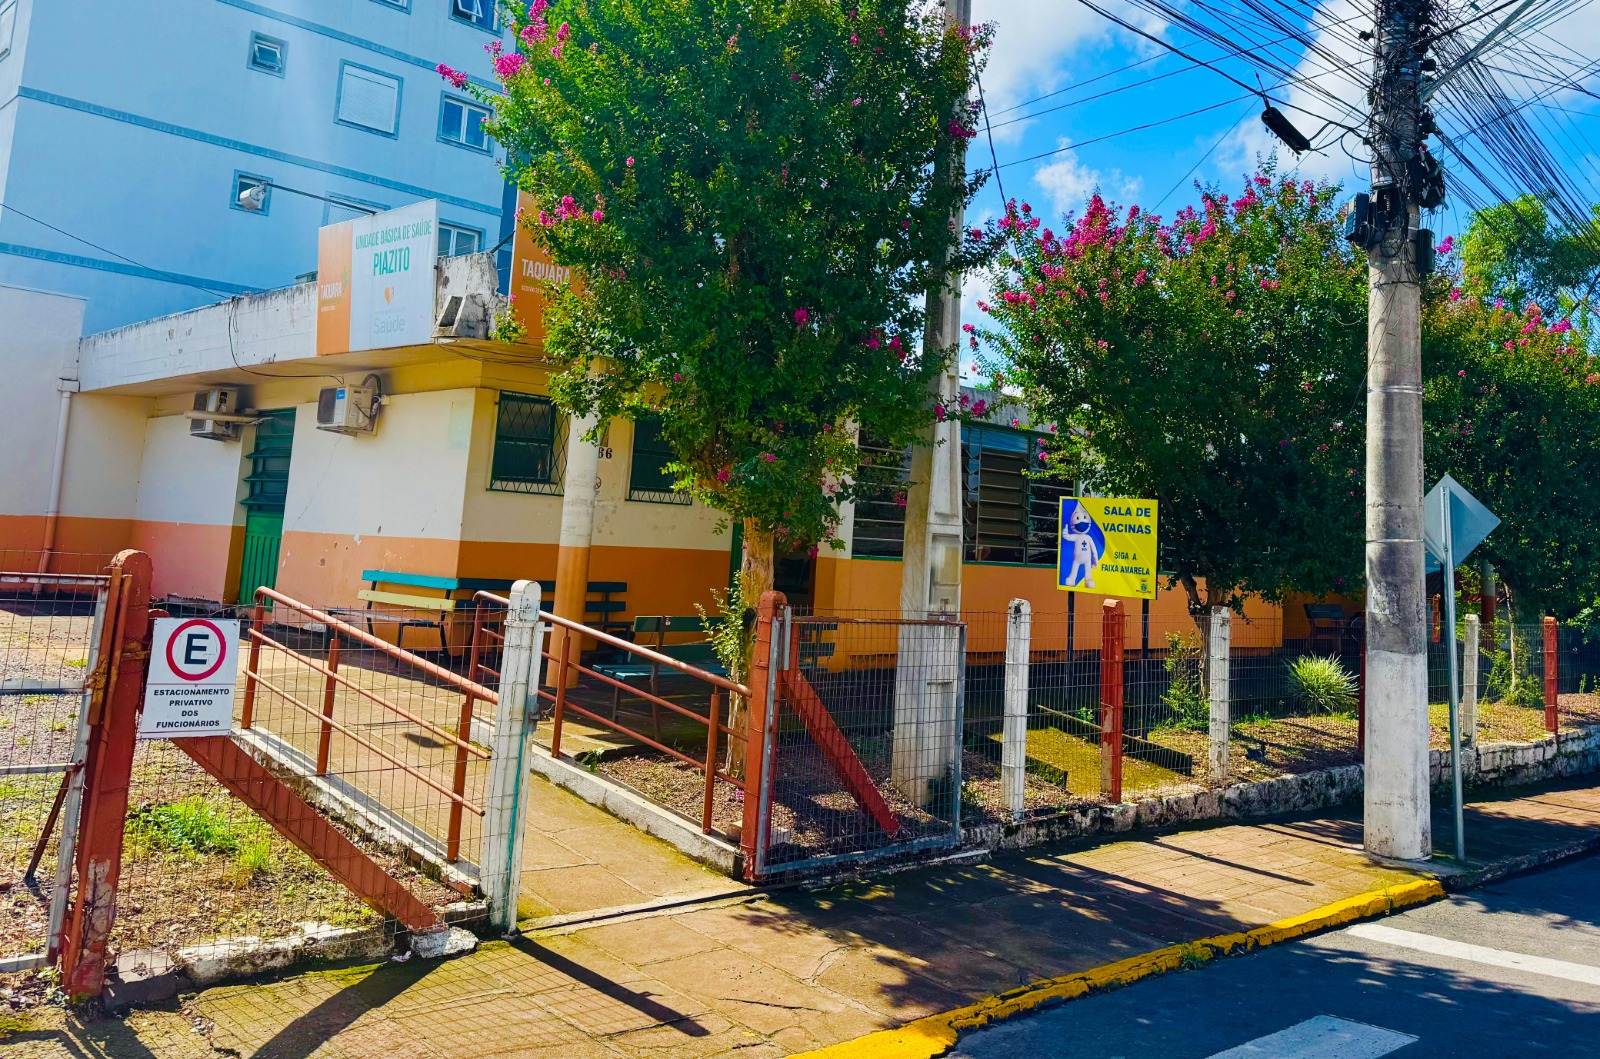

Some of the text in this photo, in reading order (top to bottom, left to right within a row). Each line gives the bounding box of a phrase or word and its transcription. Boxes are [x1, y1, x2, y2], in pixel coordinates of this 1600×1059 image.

[355, 219, 432, 250] UNIDADE BÁSICA DE SAÚDE
[372, 246, 410, 277] PIAZITO
[521, 258, 571, 284] TAQUARA
[1104, 505, 1151, 518] SALA DE
[1102, 522, 1152, 535] VACINAS
[1114, 551, 1129, 560] SIGA
[1101, 564, 1150, 575] FAIXA AMARELA
[184, 633, 209, 665] E
[153, 688, 230, 696] ESTACIONAMENTO
[169, 699, 213, 707] PRIVATIVO
[181, 709, 199, 717] DOS
[156, 719, 220, 729] FUNCIONÁRIOS
